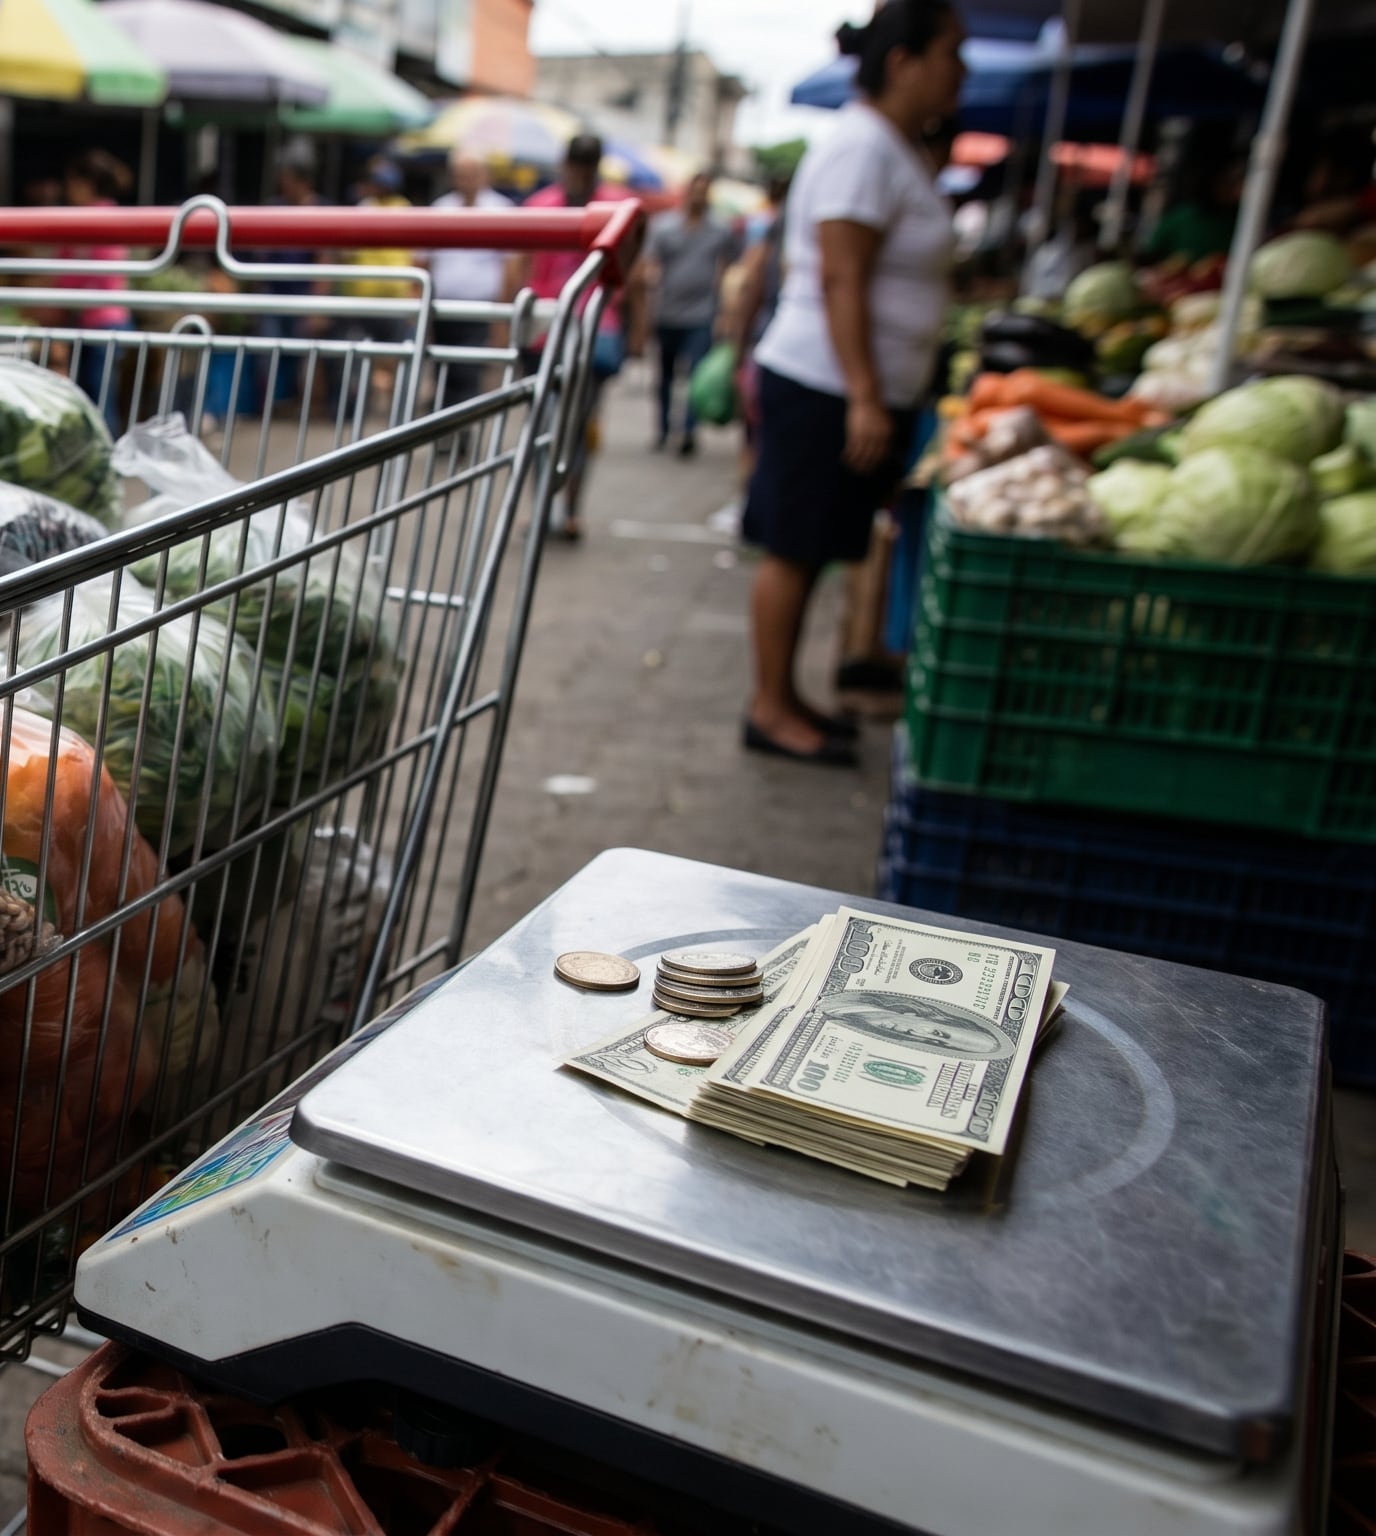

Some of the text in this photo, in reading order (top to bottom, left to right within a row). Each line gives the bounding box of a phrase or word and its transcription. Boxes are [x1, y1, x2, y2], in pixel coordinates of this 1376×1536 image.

[839, 926, 874, 974] 100
[1008, 962, 1036, 1021] 100
[797, 1060, 830, 1092] 100
[968, 1090, 1000, 1136] 100
